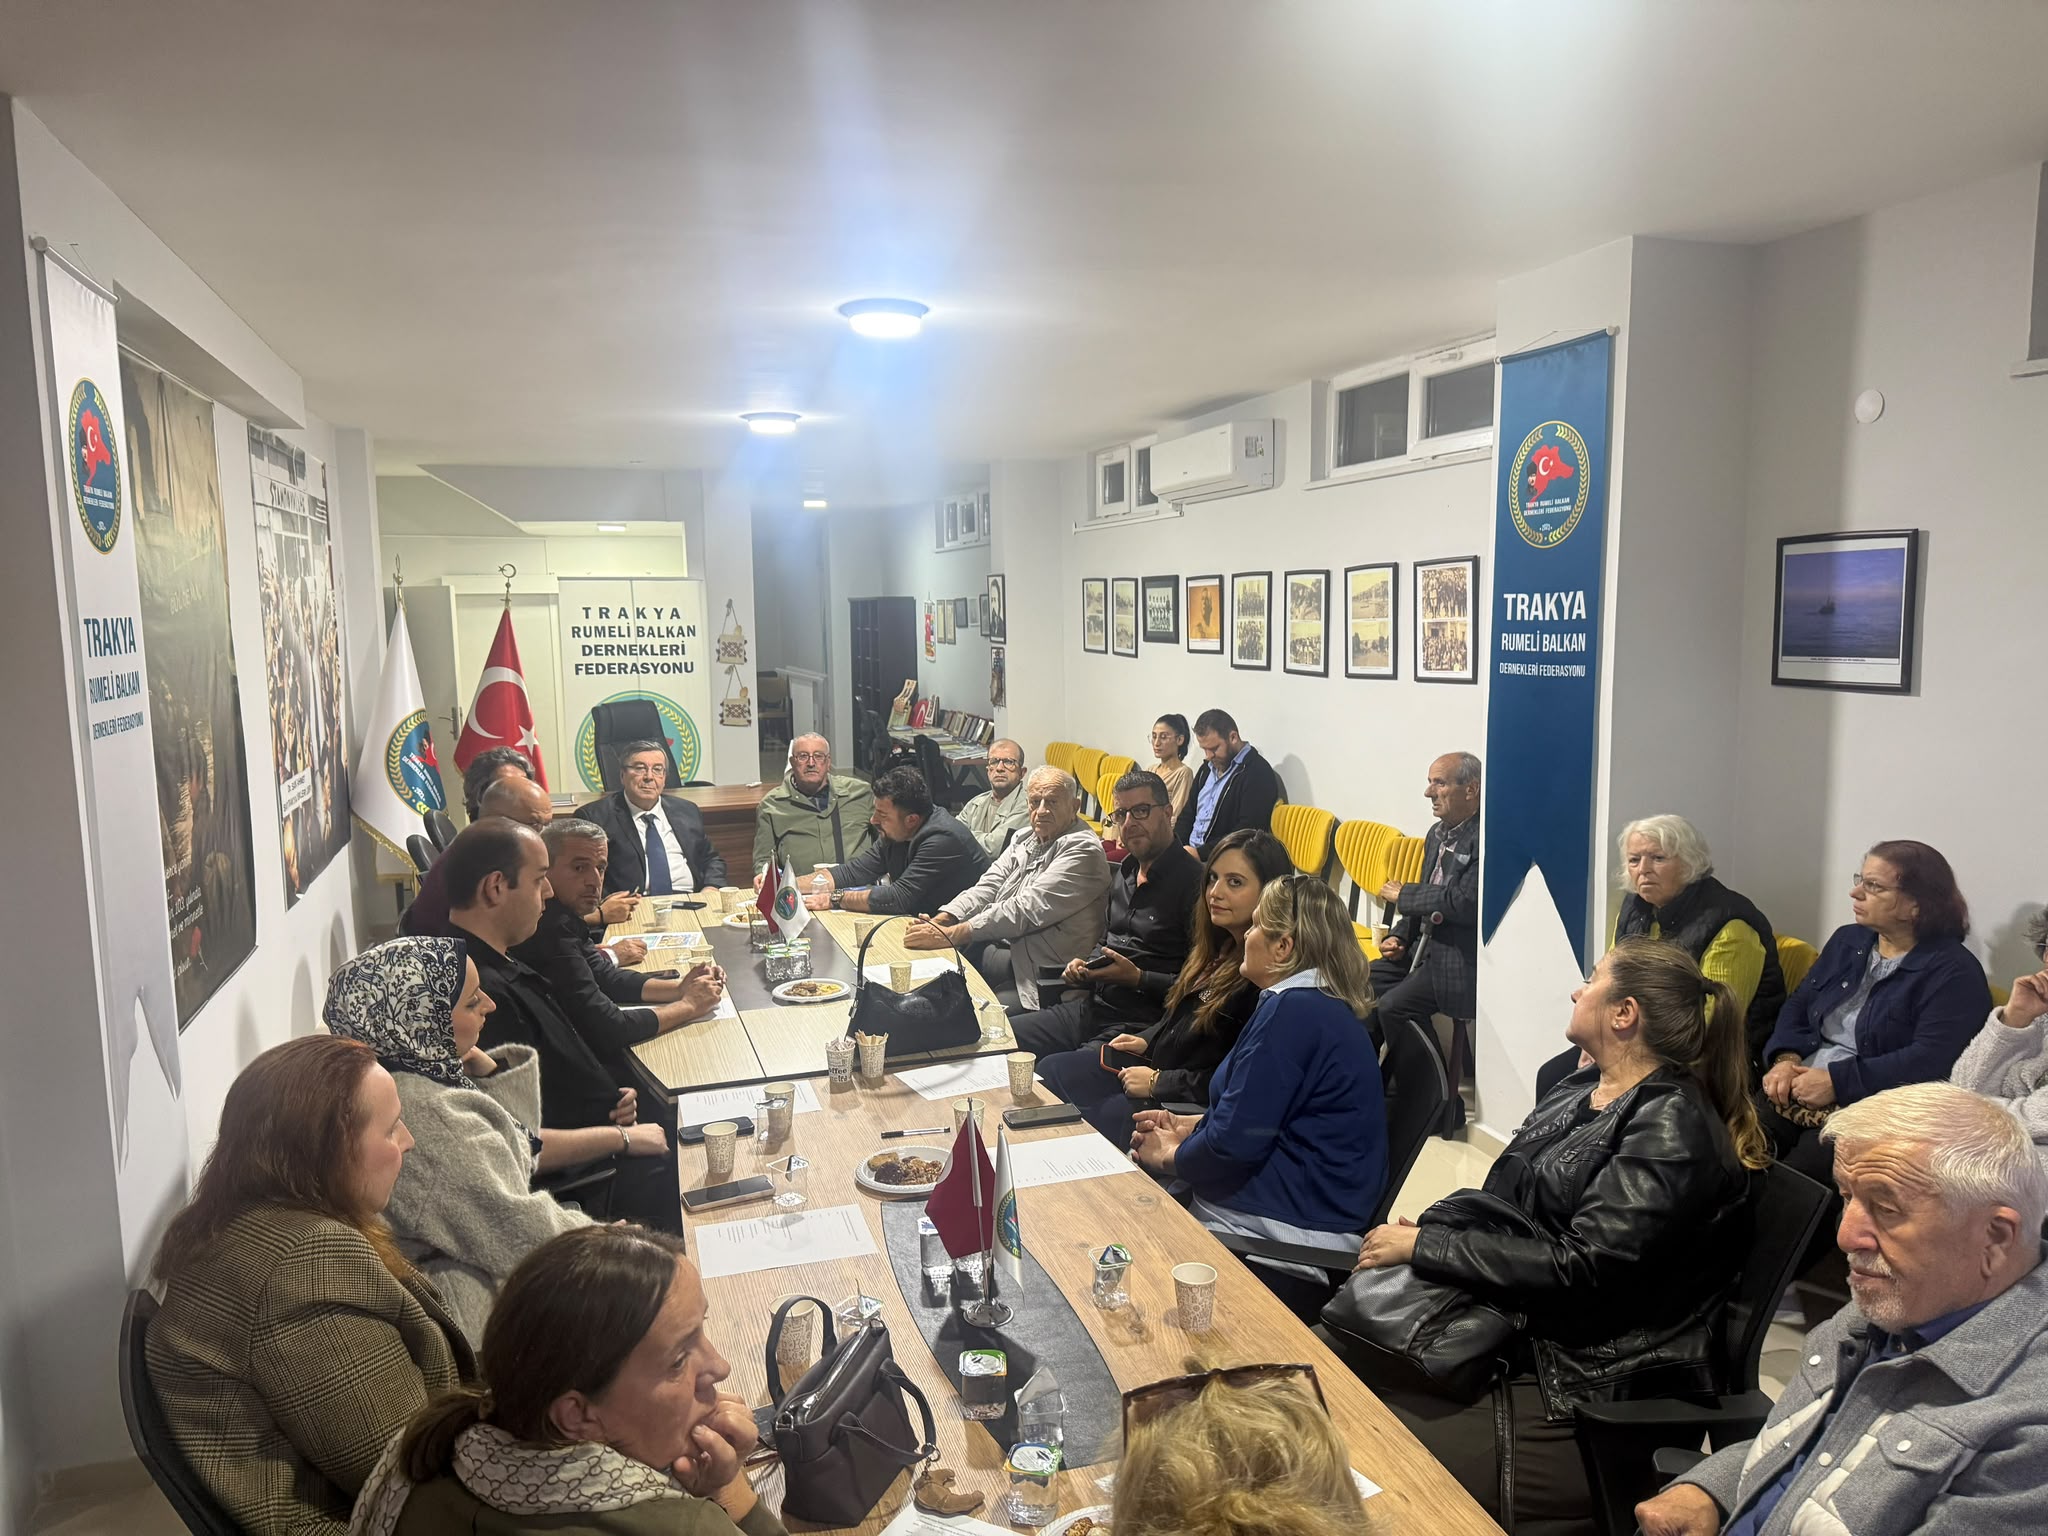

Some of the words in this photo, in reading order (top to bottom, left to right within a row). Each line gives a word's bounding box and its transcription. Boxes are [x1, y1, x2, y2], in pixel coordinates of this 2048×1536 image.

[582, 606, 681, 620] TRAKYA
[1503, 590, 1587, 621] TRAKYA
[84, 617, 136, 658] TRAKYA
[571, 622, 631, 639] RUMELİ
[636, 625, 697, 638] BALKAN
[581, 640, 686, 657] DERNEKLERİ
[1501, 630, 1540, 652] RUMELİ
[1542, 633, 1587, 652] BALKAN
[574, 661, 695, 676] FEDERASYONU
[1499, 662, 1539, 677] DERNEKLERİ
[1539, 664, 1586, 677] FEDERASYONU
[89, 670, 116, 704] RUMELİ
[116, 671, 141, 699] BALKAN
